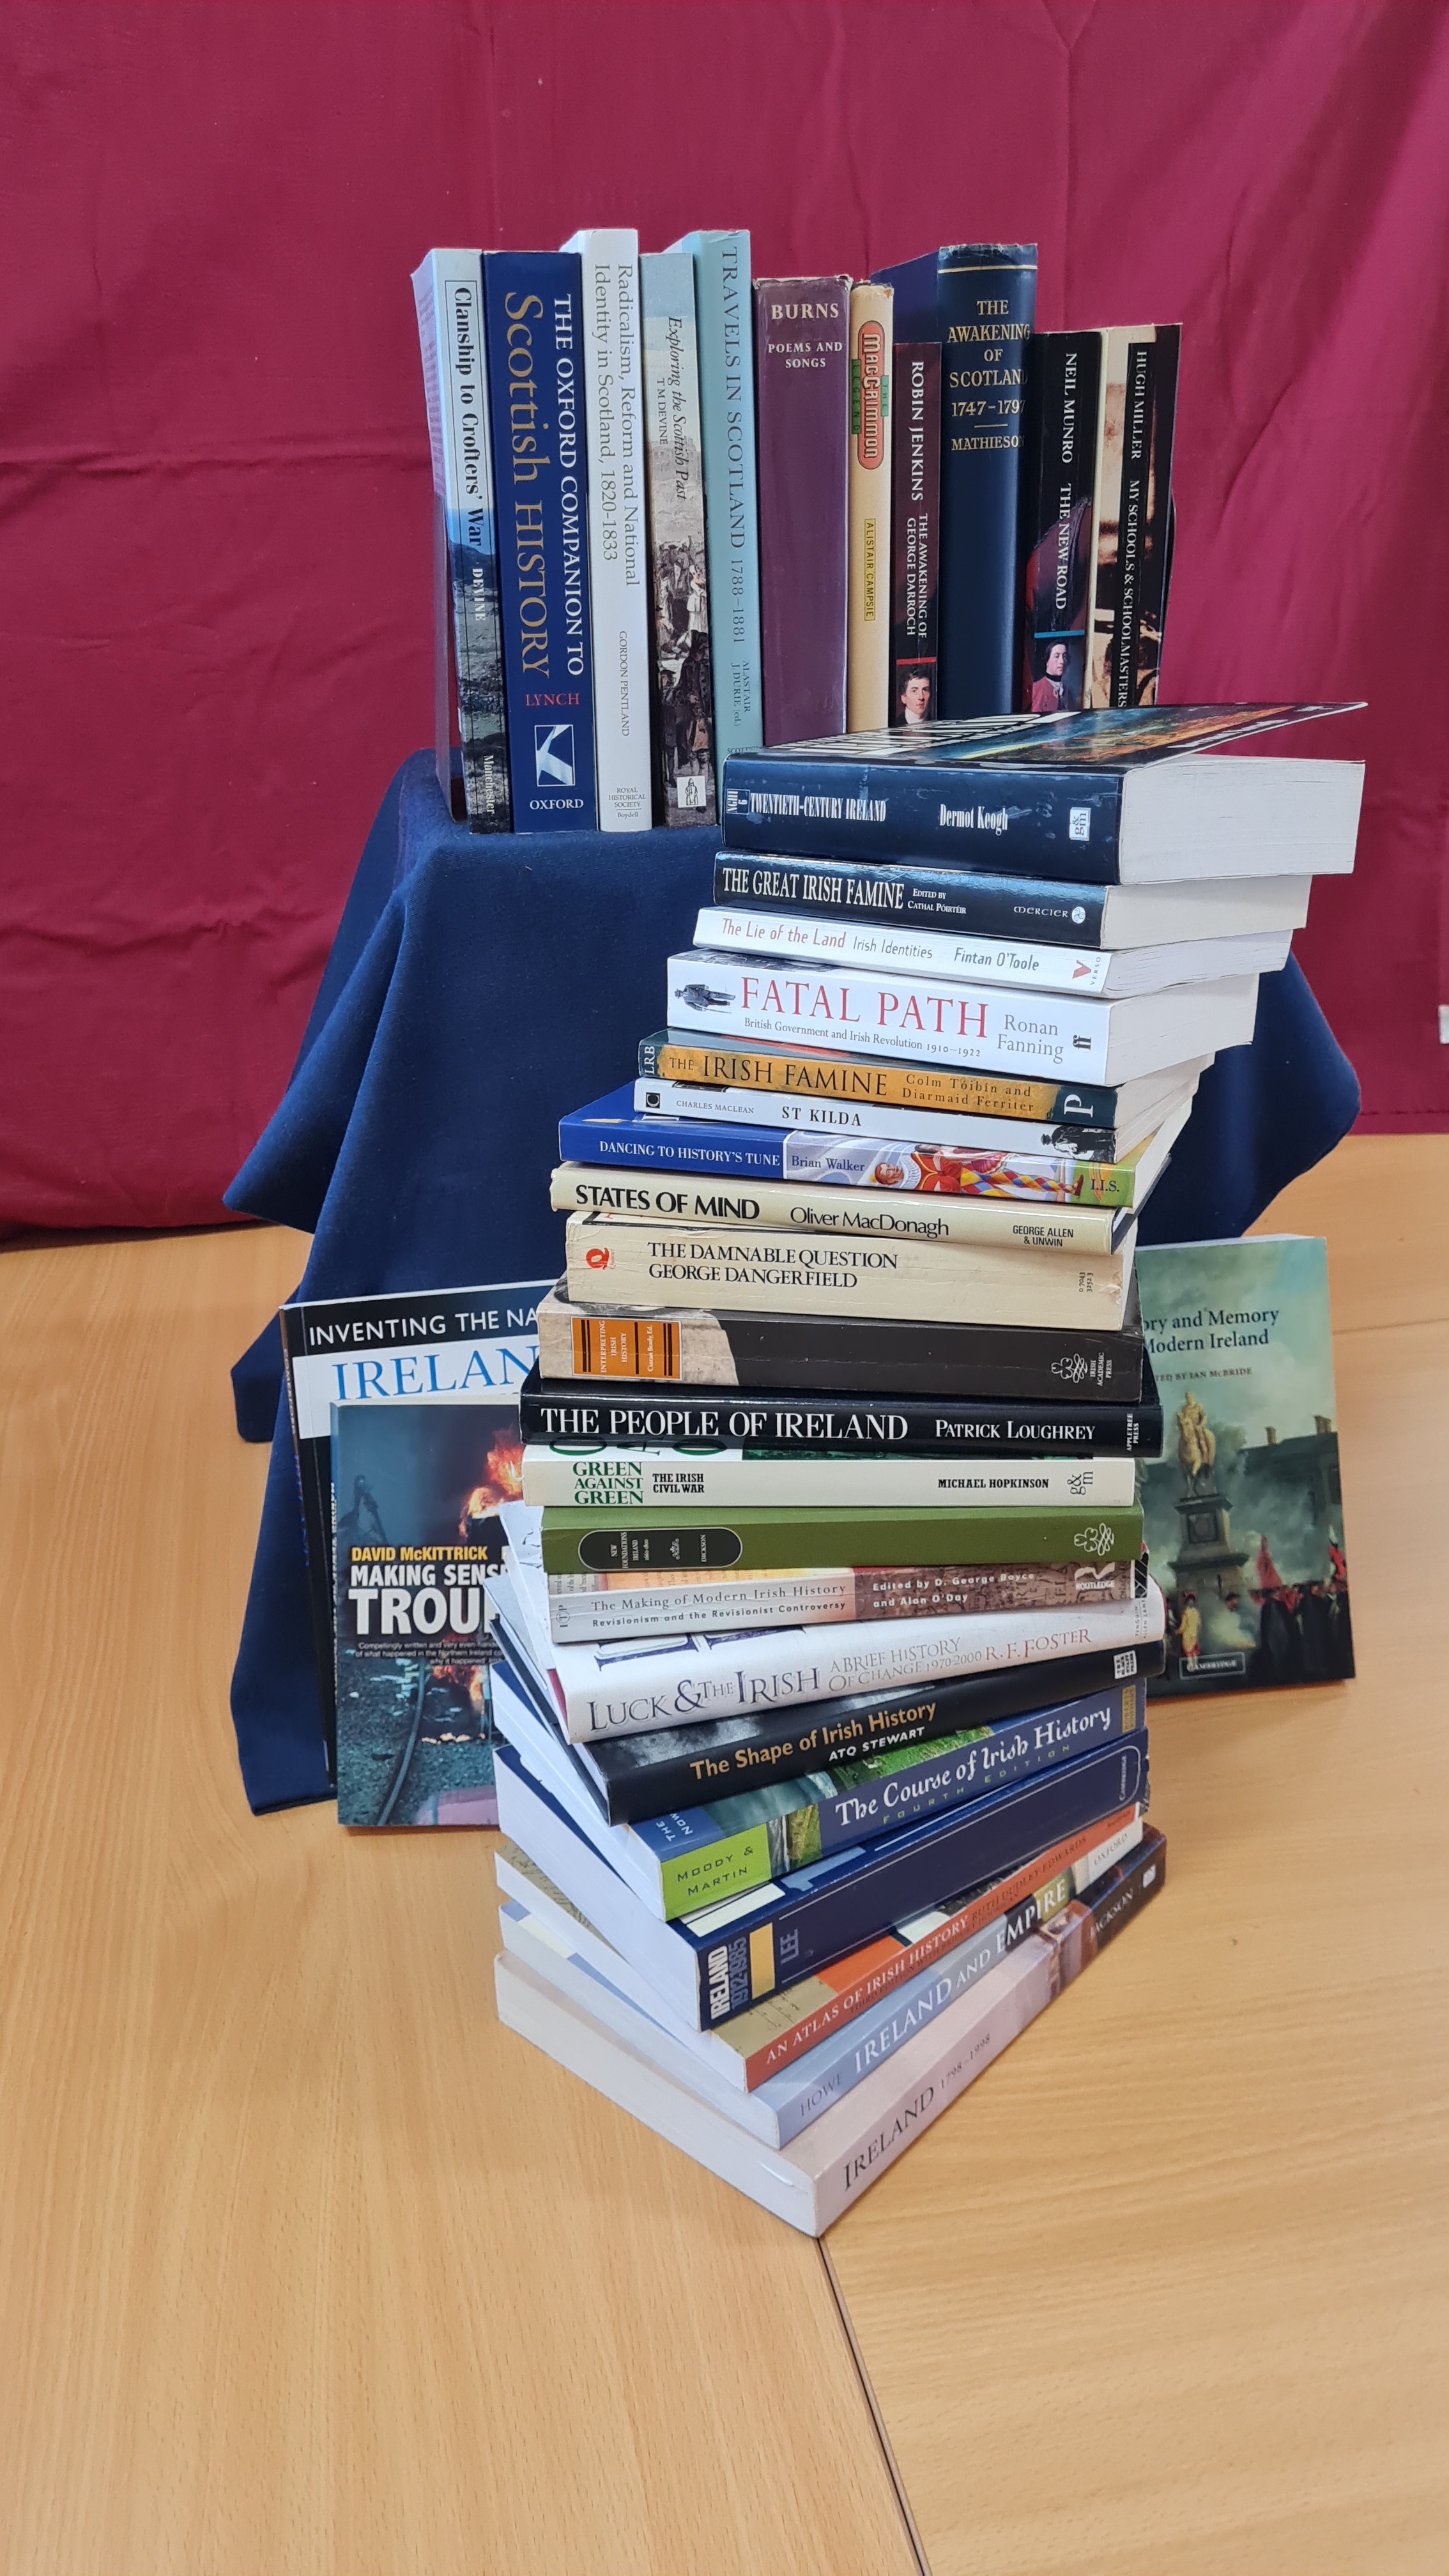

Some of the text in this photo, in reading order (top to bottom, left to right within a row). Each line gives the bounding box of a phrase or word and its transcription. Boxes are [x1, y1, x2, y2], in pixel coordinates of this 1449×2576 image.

[771, 303, 839, 320] BURNS
[454, 288, 474, 376] Clanship
[769, 341, 843, 354] POEMS AND
[785, 358, 827, 369] SONGS
[461, 385, 473, 404] to
[666, 316, 690, 500] Exploring the Scottish Past
[722, 246, 746, 548] TRAVELS IN SCOTLAND
[1061, 353, 1077, 463] NEIL MUNRO
[1131, 351, 1148, 459] HUGH MILLER
[592, 264, 617, 560] Identity in Scotland, 1820-1833
[617, 264, 640, 586] Radicalism, Reform and National
[908, 361, 924, 500] ROBIN JENKINS
[505, 292, 549, 678] Scottish HISTORY
[554, 294, 583, 675] THE OXFORD COMPANION TO
[469, 507, 483, 546] War
[1056, 483, 1071, 610] THE NEW ROAD
[907, 518, 916, 635] GEORGE DARROCH
[918, 513, 928, 638] THE AWAKENING OF
[473, 568, 486, 622] DEVINE
[1118, 480, 1140, 707] MY SCHOOLS & SCHOOLMASTERS
[619, 631, 629, 737] GORDON PENTLAND
[526, 693, 579, 706] LYNCH
[484, 755, 495, 815] Manchester
[530, 798, 583, 810] OXFORD
[617, 811, 638, 820] Boydell
[751, 792, 886, 822] TWENTIETH-CENTURY IRELAND
[940, 804, 1008, 837] Dermot Keogh
[723, 868, 904, 908] THE GREAT IRISH FAMINE
[723, 918, 846, 947] The Lie of the Land
[853, 937, 933, 958] Irish Identities
[954, 947, 992, 965] Fintan
[741, 977, 989, 1038] FATAL PATH
[1004, 1014, 1058, 1035] Ronan
[997, 1034, 1064, 1064] Fanning
[670, 1055, 887, 1096] THE IRISH FAMINE
[677, 1100, 755, 1114] CHARLES MACLEAN
[782, 1107, 862, 1126] ST KILDA
[600, 1140, 654, 1156] DANCING
[657, 1146, 674, 1158] TO
[746, 1153, 780, 1166] TUNE
[792, 1156, 865, 1172] Brian Walker
[576, 1184, 760, 1220] STATES OF MIND
[790, 1207, 949, 1238] Oliver MacDonagh
[648, 1242, 898, 1269] THE DAMNABLE QUESTION
[649, 1264, 857, 1288] GEORGE DANGERFIELD
[309, 1311, 500, 1346] INVENTING THE
[1172, 1309, 1280, 1329] and Memory
[1210, 1329, 1269, 1349] Ireland
[541, 1409, 908, 1440] THE PEOPLE OF IRELAND
[573, 1462, 641, 1476] GREEN
[574, 1477, 643, 1489] AGAINST
[653, 1473, 705, 1483] THE IRISH
[938, 1478, 1049, 1488] MICHAEL HOPKINSON
[574, 1491, 643, 1504] GREEN
[653, 1484, 705, 1494] CIVIL WAR
[352, 1545, 487, 1561] DAVID McKITTRICK
[351, 1565, 436, 1587] MAKING
[592, 1584, 846, 1611] The Making of Modern Irish History
[690, 1702, 936, 1779] The Shape of Irish History
[835, 1797, 878, 1826] The
[884, 1767, 951, 1808] Course
[956, 1750, 977, 1782] of
[983, 1736, 1029, 1770] Irish
[1034, 1706, 1112, 1749] History
[801, 2073, 843, 2116] HOWE
[855, 1977, 952, 2073] IRELAND
[956, 1949, 991, 1988] AND
[995, 1878, 1067, 1953] EMPIRE
[844, 2086, 935, 2191] IRELAND
